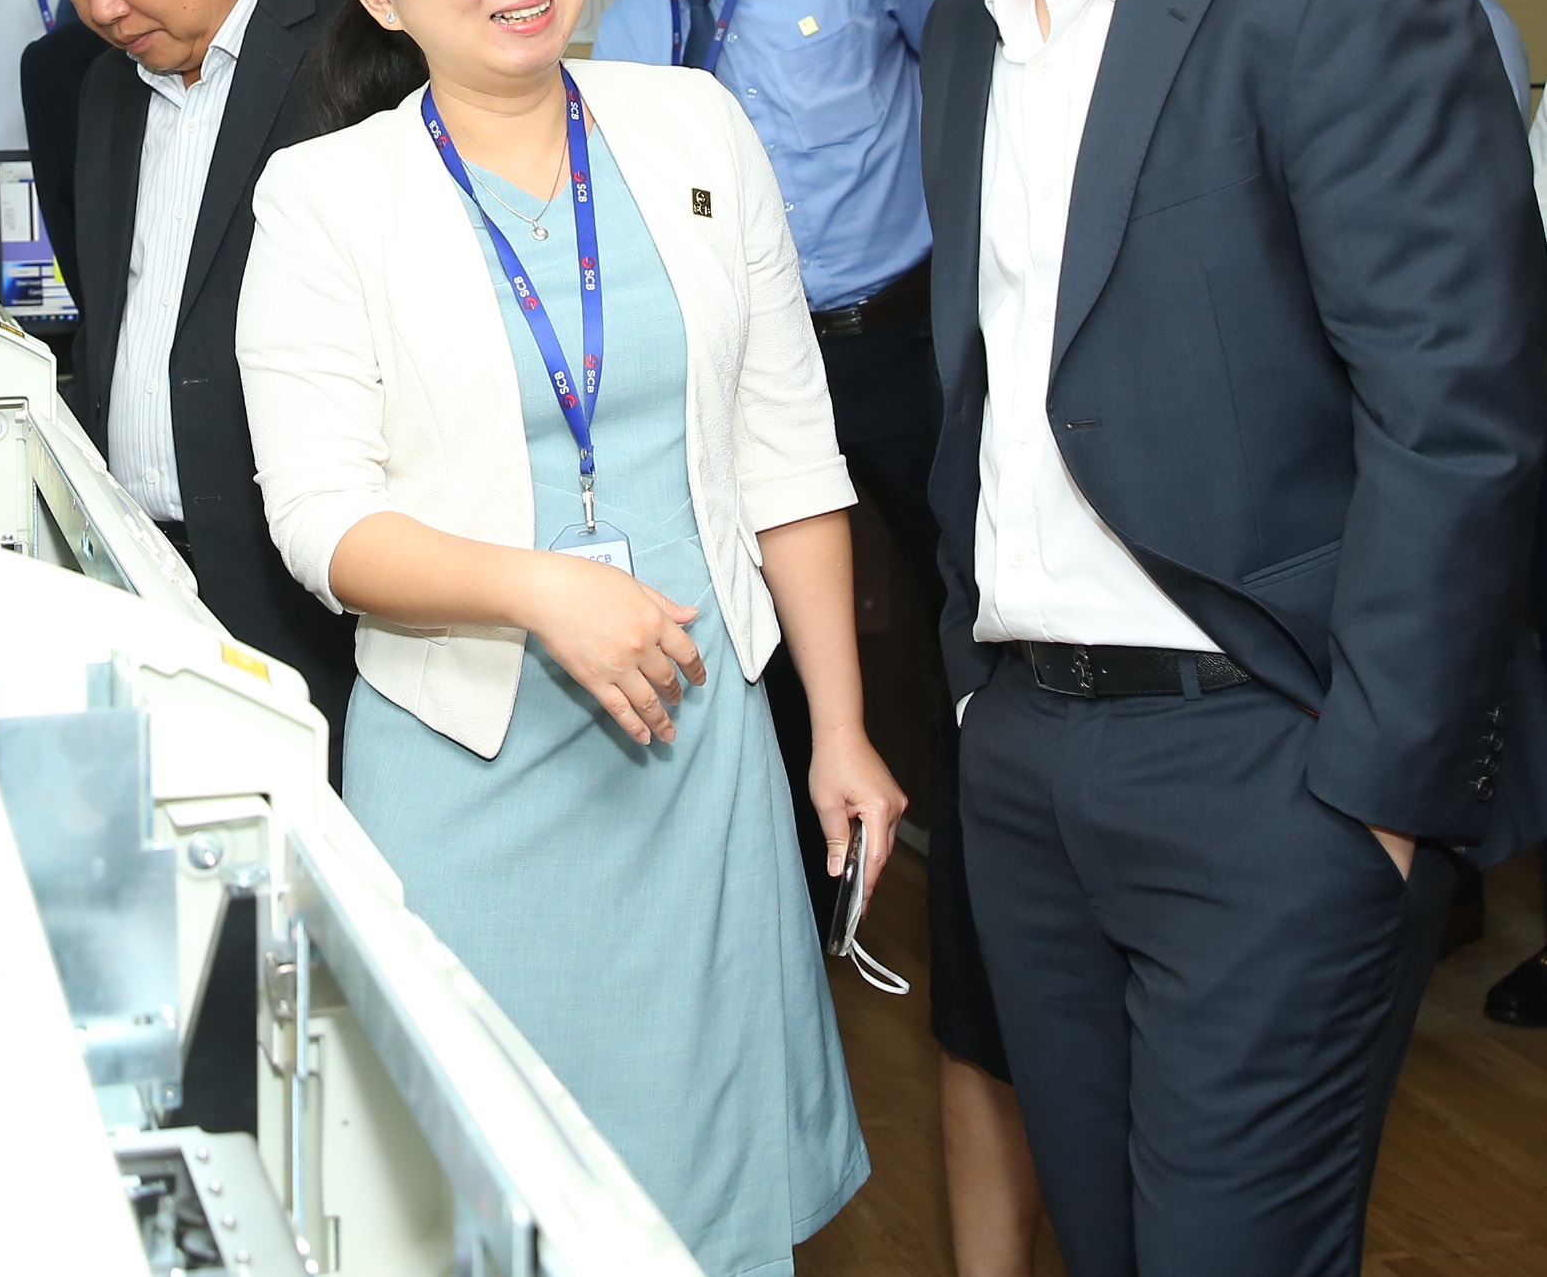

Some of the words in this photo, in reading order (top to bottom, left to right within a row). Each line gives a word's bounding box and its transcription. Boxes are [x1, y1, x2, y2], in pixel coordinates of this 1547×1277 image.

[569, 100, 580, 121] SCB
[428, 119, 442, 140] SCB
[576, 182, 588, 203] SCB
[513, 274, 530, 298] SCB
[584, 268, 596, 292] SCB
[554, 370, 570, 395] SCB
[586, 368, 596, 394] SCB
